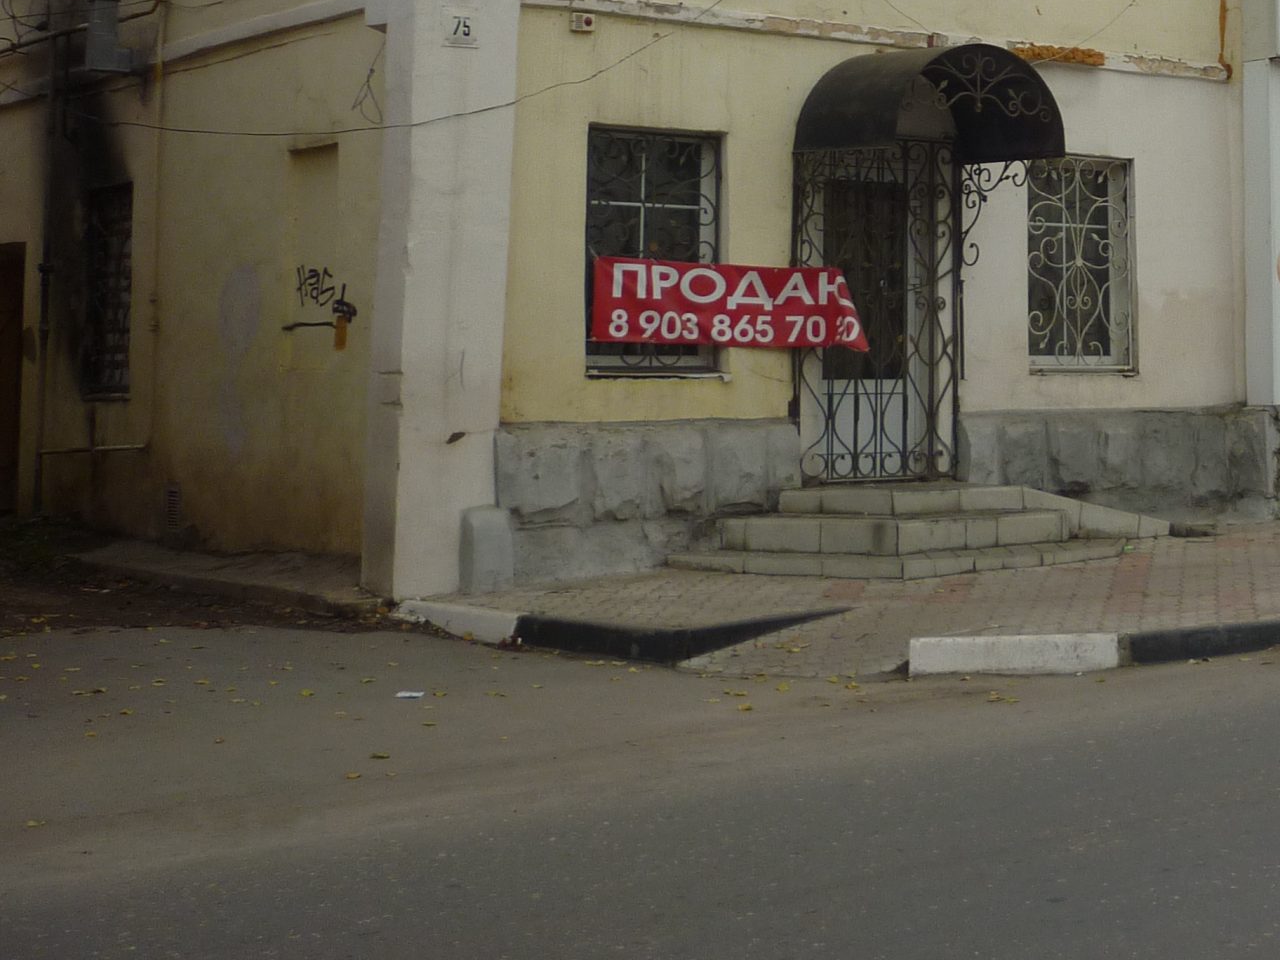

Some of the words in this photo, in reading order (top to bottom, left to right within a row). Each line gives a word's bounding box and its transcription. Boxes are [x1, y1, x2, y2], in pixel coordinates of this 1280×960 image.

[453, 16, 470, 36] 75
[609, 309, 628, 337] 8
[639, 310, 699, 340] 903
[711, 314, 774, 343] 865
[785, 315, 826, 342] 70
